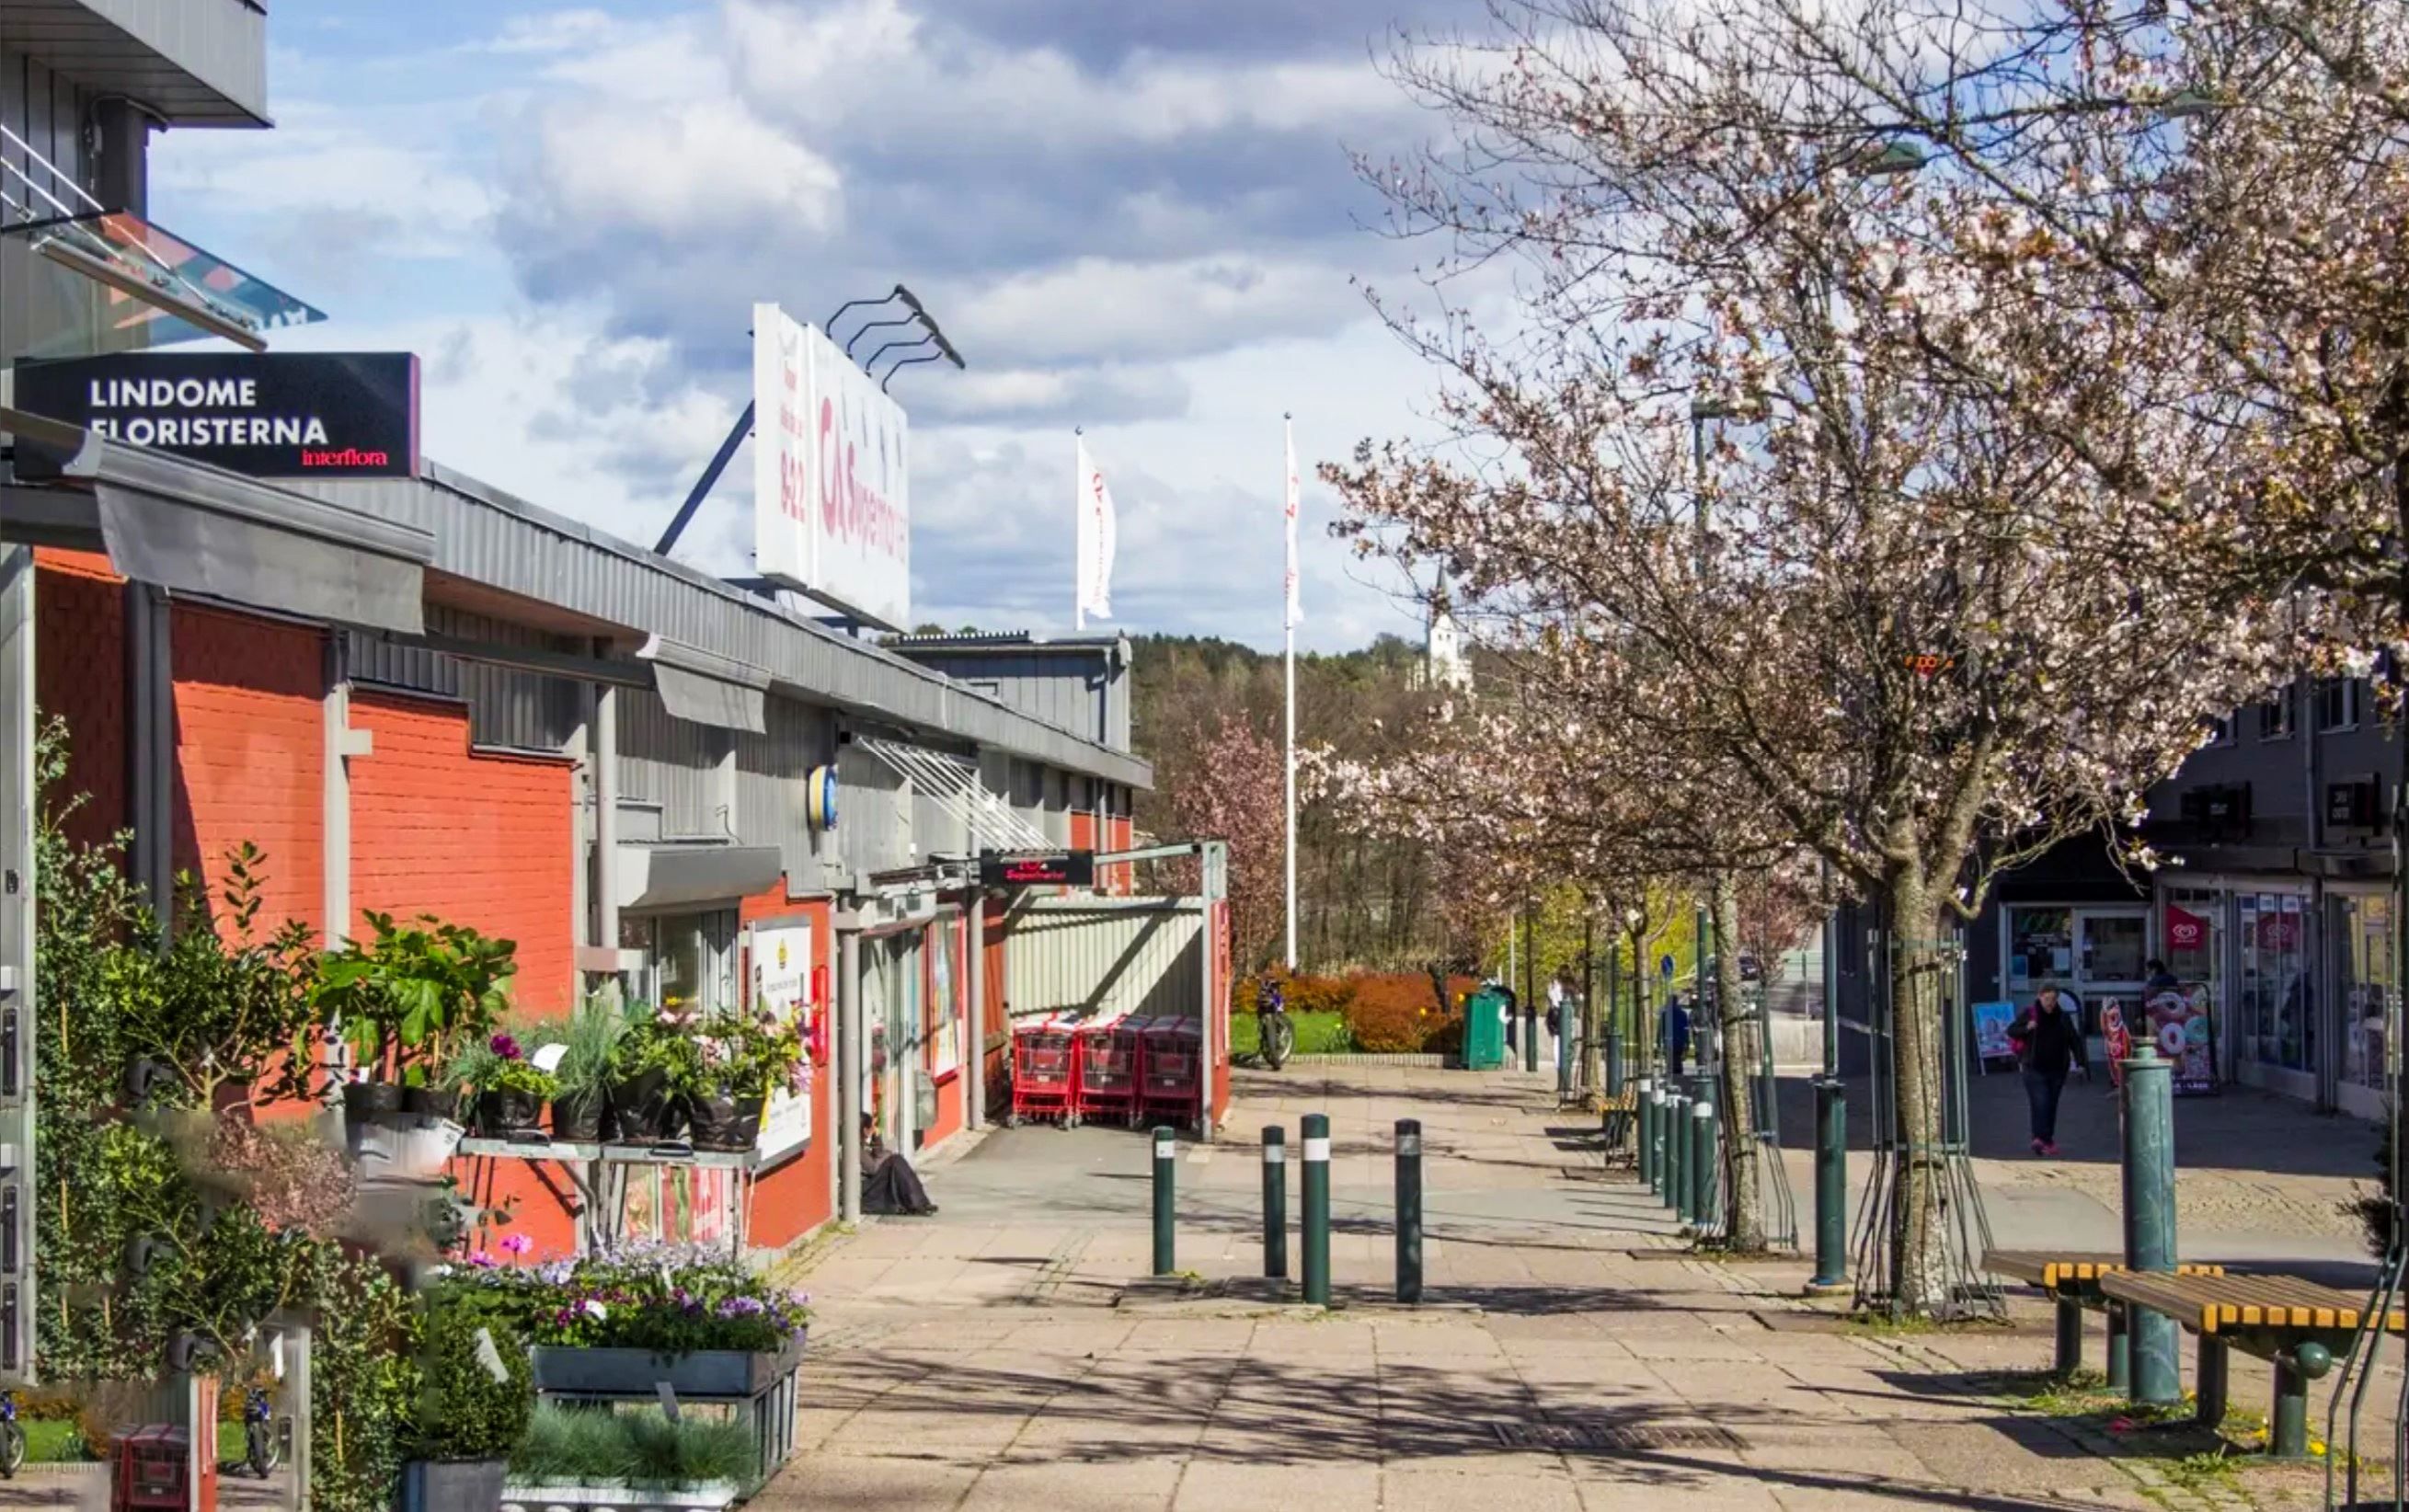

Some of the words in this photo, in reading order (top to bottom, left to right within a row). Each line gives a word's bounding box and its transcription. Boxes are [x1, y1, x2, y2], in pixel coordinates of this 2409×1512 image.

[90, 379, 257, 407] LINDOME
[90, 417, 329, 446] FLORISTERNA
[302, 448, 388, 466] interflora
